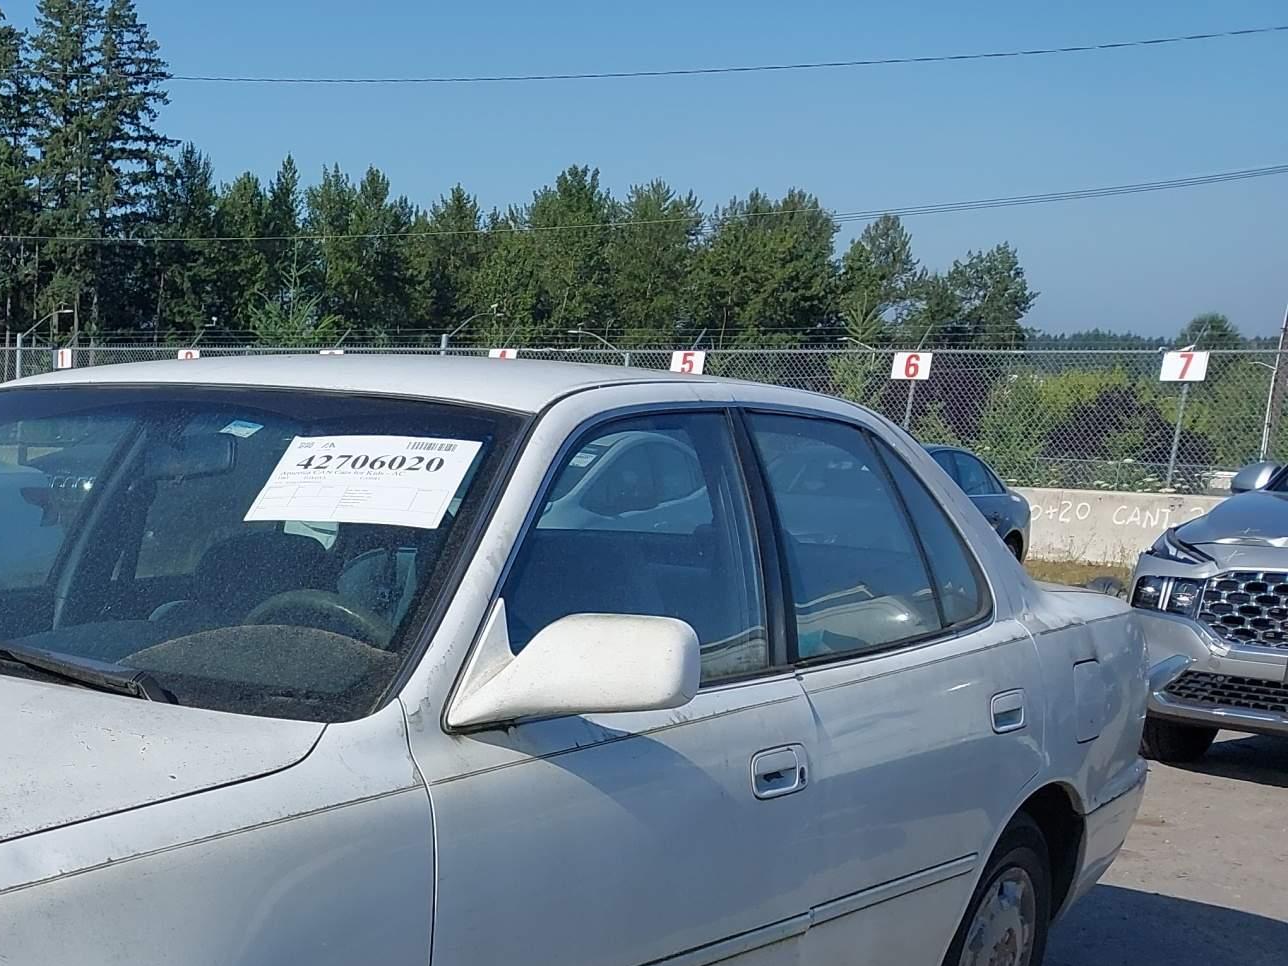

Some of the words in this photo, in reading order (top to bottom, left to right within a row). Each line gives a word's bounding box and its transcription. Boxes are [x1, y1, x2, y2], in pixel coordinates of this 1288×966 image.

[680, 352, 694, 373] 5
[904, 353, 920, 378] 6
[1178, 353, 1194, 379] 7
[296, 454, 445, 473] 42706020
